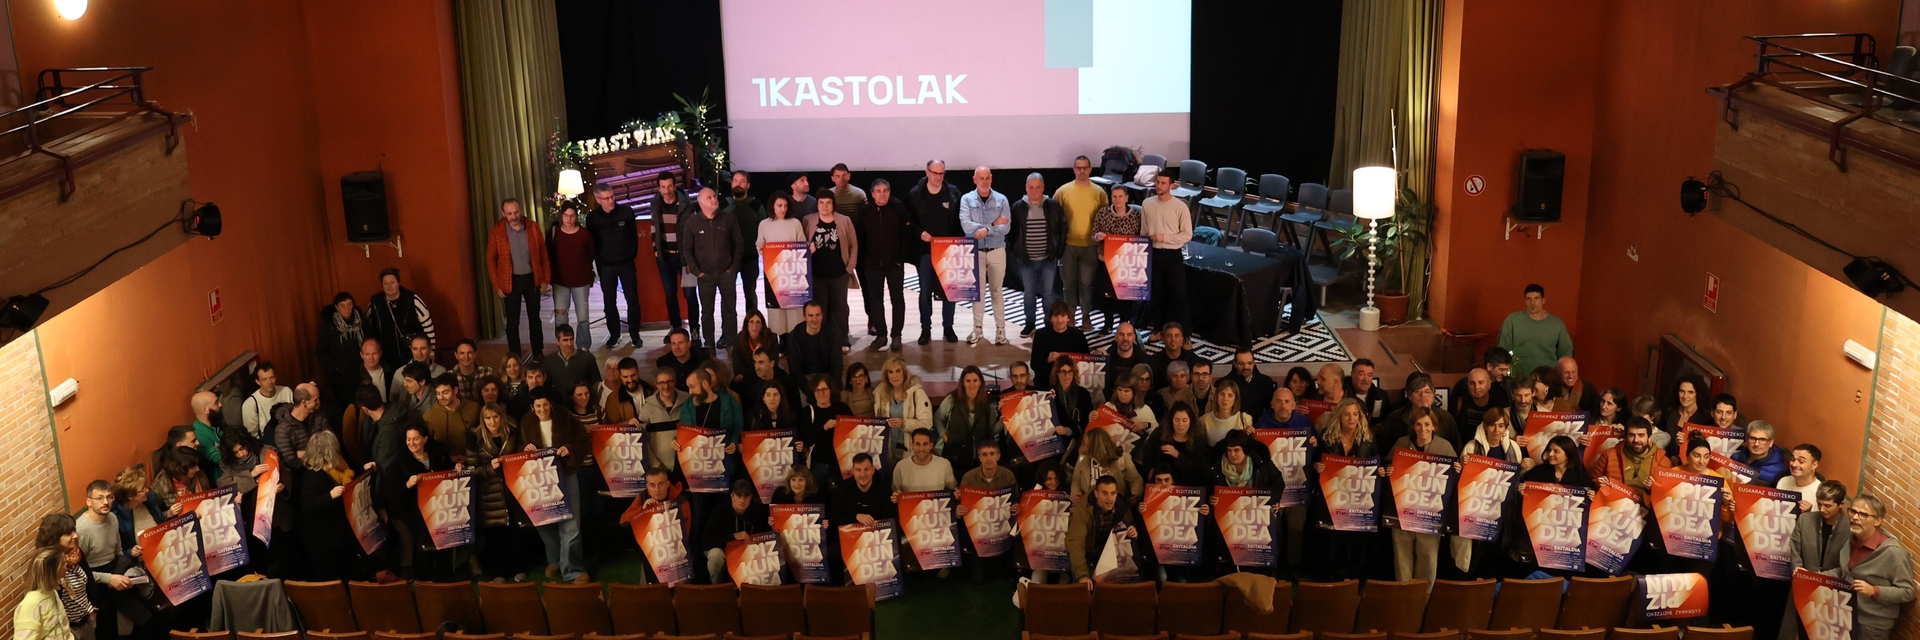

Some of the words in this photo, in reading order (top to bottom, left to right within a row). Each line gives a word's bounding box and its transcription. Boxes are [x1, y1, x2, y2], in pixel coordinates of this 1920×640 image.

[782, 249, 807, 262] PIZ
[949, 244, 975, 257] PIZ
[1123, 242, 1149, 256] PIZ
[774, 262, 807, 275] KUN
[942, 256, 975, 270] KUN
[1115, 255, 1148, 269] KUN
[778, 275, 809, 288] DEA
[946, 269, 976, 283] DEA
[1118, 267, 1148, 281] DEA
[1078, 361, 1106, 375] PIZ
[1080, 374, 1105, 389] UN
[1023, 391, 1051, 409] PIZ
[1014, 404, 1052, 425] KUN
[856, 424, 886, 440] PIZ
[1021, 421, 1057, 439] DEA
[1112, 422, 1141, 448] PIZ
[1553, 421, 1585, 435] PIZ
[615, 433, 643, 447] PIZ
[697, 434, 726, 448] PIZ
[764, 437, 794, 451] PIZ
[845, 438, 884, 454] KUN
[1276, 436, 1307, 452] PIZ
[607, 446, 643, 460] KUN
[687, 446, 726, 460] KUN
[754, 451, 794, 467] KUN
[1326, 456, 1351, 464] EUSKARAZ
[1399, 451, 1424, 460] EUSKARAZ
[526, 456, 557, 474] PIZ
[610, 460, 645, 474] DEA
[690, 460, 725, 473] DEA
[1345, 465, 1378, 479] PIZ
[1418, 461, 1451, 479] PIZ
[1469, 457, 1494, 466] EUSKARAZ
[1495, 462, 1518, 471] BIZITZEKO
[1728, 462, 1754, 476] BIZITZEKO
[518, 469, 559, 490] KUN
[1282, 466, 1307, 482] EA
[1483, 468, 1516, 486] PIZ
[1658, 471, 1687, 480] EUSKARAZ
[1689, 475, 1718, 485] BIZITZEKO
[441, 477, 471, 493] PIZ
[1332, 477, 1376, 493] KUN
[1403, 473, 1447, 495] KUN
[1469, 480, 1511, 502] KUN
[1557, 487, 1585, 495] BIZITZEKO
[1609, 481, 1632, 496] EUSKARAZ
[429, 490, 470, 510] KUN
[526, 484, 563, 503] DEA
[1336, 491, 1375, 506] DEA
[1405, 489, 1443, 509] DEA
[1679, 481, 1717, 504] PIZ
[1738, 486, 1765, 496] EUSKARAZ
[1768, 491, 1796, 500] BIZITZEKO
[202, 493, 235, 516] PIZ
[921, 498, 951, 513] PIZ
[983, 493, 1012, 510] PIZ
[1040, 499, 1071, 514] PIZ
[1168, 496, 1200, 511] PIZ
[1237, 495, 1272, 511] PIZ
[1467, 496, 1502, 518] DEA
[1549, 494, 1585, 513] PIZ
[1618, 497, 1640, 518] PI
[1666, 496, 1714, 520] KUN
[1759, 497, 1797, 519] PIZ
[434, 507, 471, 525] DEA
[653, 508, 681, 529] PIZ
[791, 513, 820, 529] PIZ
[911, 513, 951, 529] KUN
[972, 507, 1012, 522] KUN
[1029, 513, 1070, 531] KUN
[1156, 510, 1198, 526] KUN
[1227, 510, 1271, 525] KUN
[1536, 508, 1583, 528] KUN
[978, 521, 1012, 537] DEA
[1600, 506, 1642, 540] KUN
[1669, 513, 1713, 536] DEA
[1748, 513, 1796, 534] KUN
[165, 521, 197, 546] PIZ
[203, 526, 241, 548] DEA
[646, 524, 683, 547] KUN
[782, 528, 821, 544] KUN
[862, 528, 893, 546] PIZ
[917, 527, 955, 545] DEA
[1032, 530, 1067, 547] DEA
[1159, 526, 1198, 541] DEA
[1233, 525, 1272, 541] DEA
[1540, 524, 1582, 545] DEA
[1593, 521, 1633, 553] DEA
[158, 534, 199, 566] KUN
[653, 540, 687, 562] DEA
[748, 540, 779, 560] PIZ
[792, 544, 823, 560] DEA
[854, 544, 893, 563] KUN
[163, 552, 202, 581] DEA
[741, 556, 780, 576] KUN
[859, 560, 897, 579] DEA
[1645, 575, 1690, 593] KUN
[1797, 573, 1823, 583] EUSKARAZ
[1646, 593, 1680, 611] PIZ
[1819, 585, 1853, 611] PIZ
[1809, 601, 1852, 630] KUN
